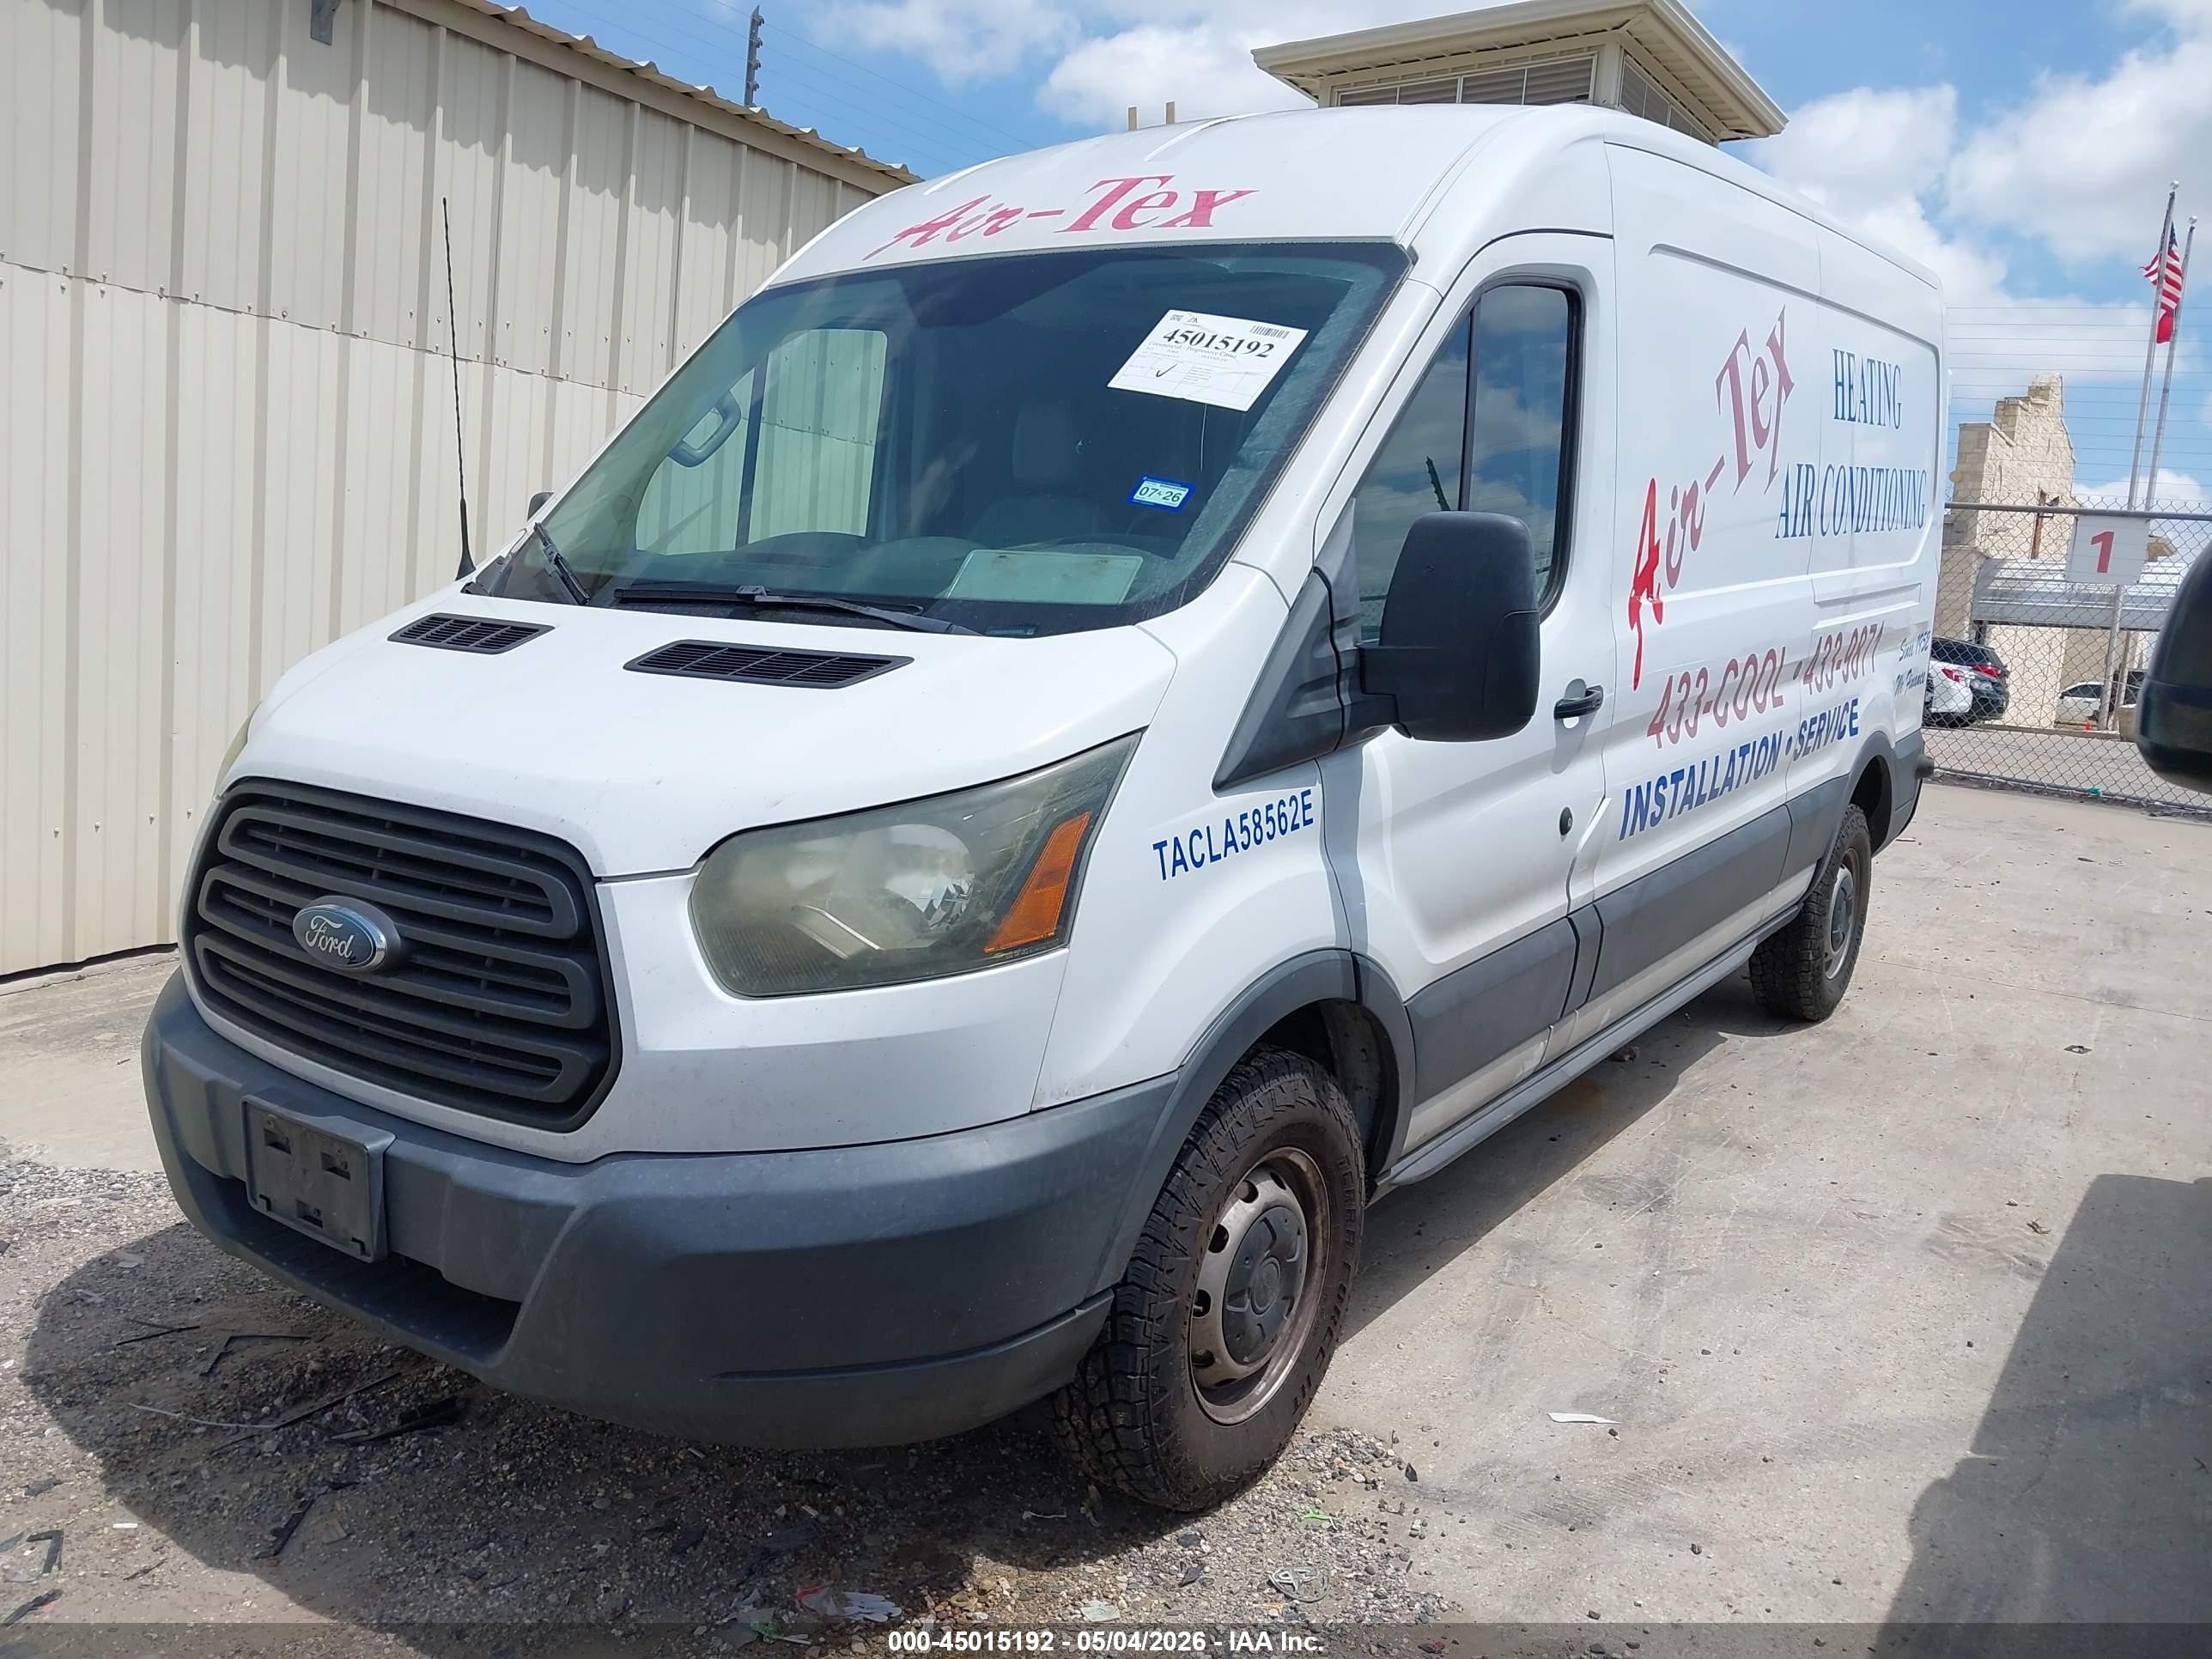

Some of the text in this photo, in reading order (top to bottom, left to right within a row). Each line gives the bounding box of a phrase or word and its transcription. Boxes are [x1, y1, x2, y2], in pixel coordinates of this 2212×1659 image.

[861, 174, 1260, 261] Air-Tex
[1163, 328, 1275, 359] 45015192
[1832, 348, 1903, 430] HEATING
[1139, 486, 1182, 502] 07 26
[1628, 304, 1795, 692] Air-Tex
[1774, 462, 1927, 540] AIR CONDITIONING
[2089, 530, 2115, 574] 1
[1647, 646, 1785, 750] 433-COOL
[1802, 620, 1885, 696] 433-9871
[1619, 729, 1784, 842] INSTALLATION
[1793, 698, 1859, 763] SERVICE
[1152, 788, 1314, 881] TACLA58562E
[305, 915, 356, 958] Ford
